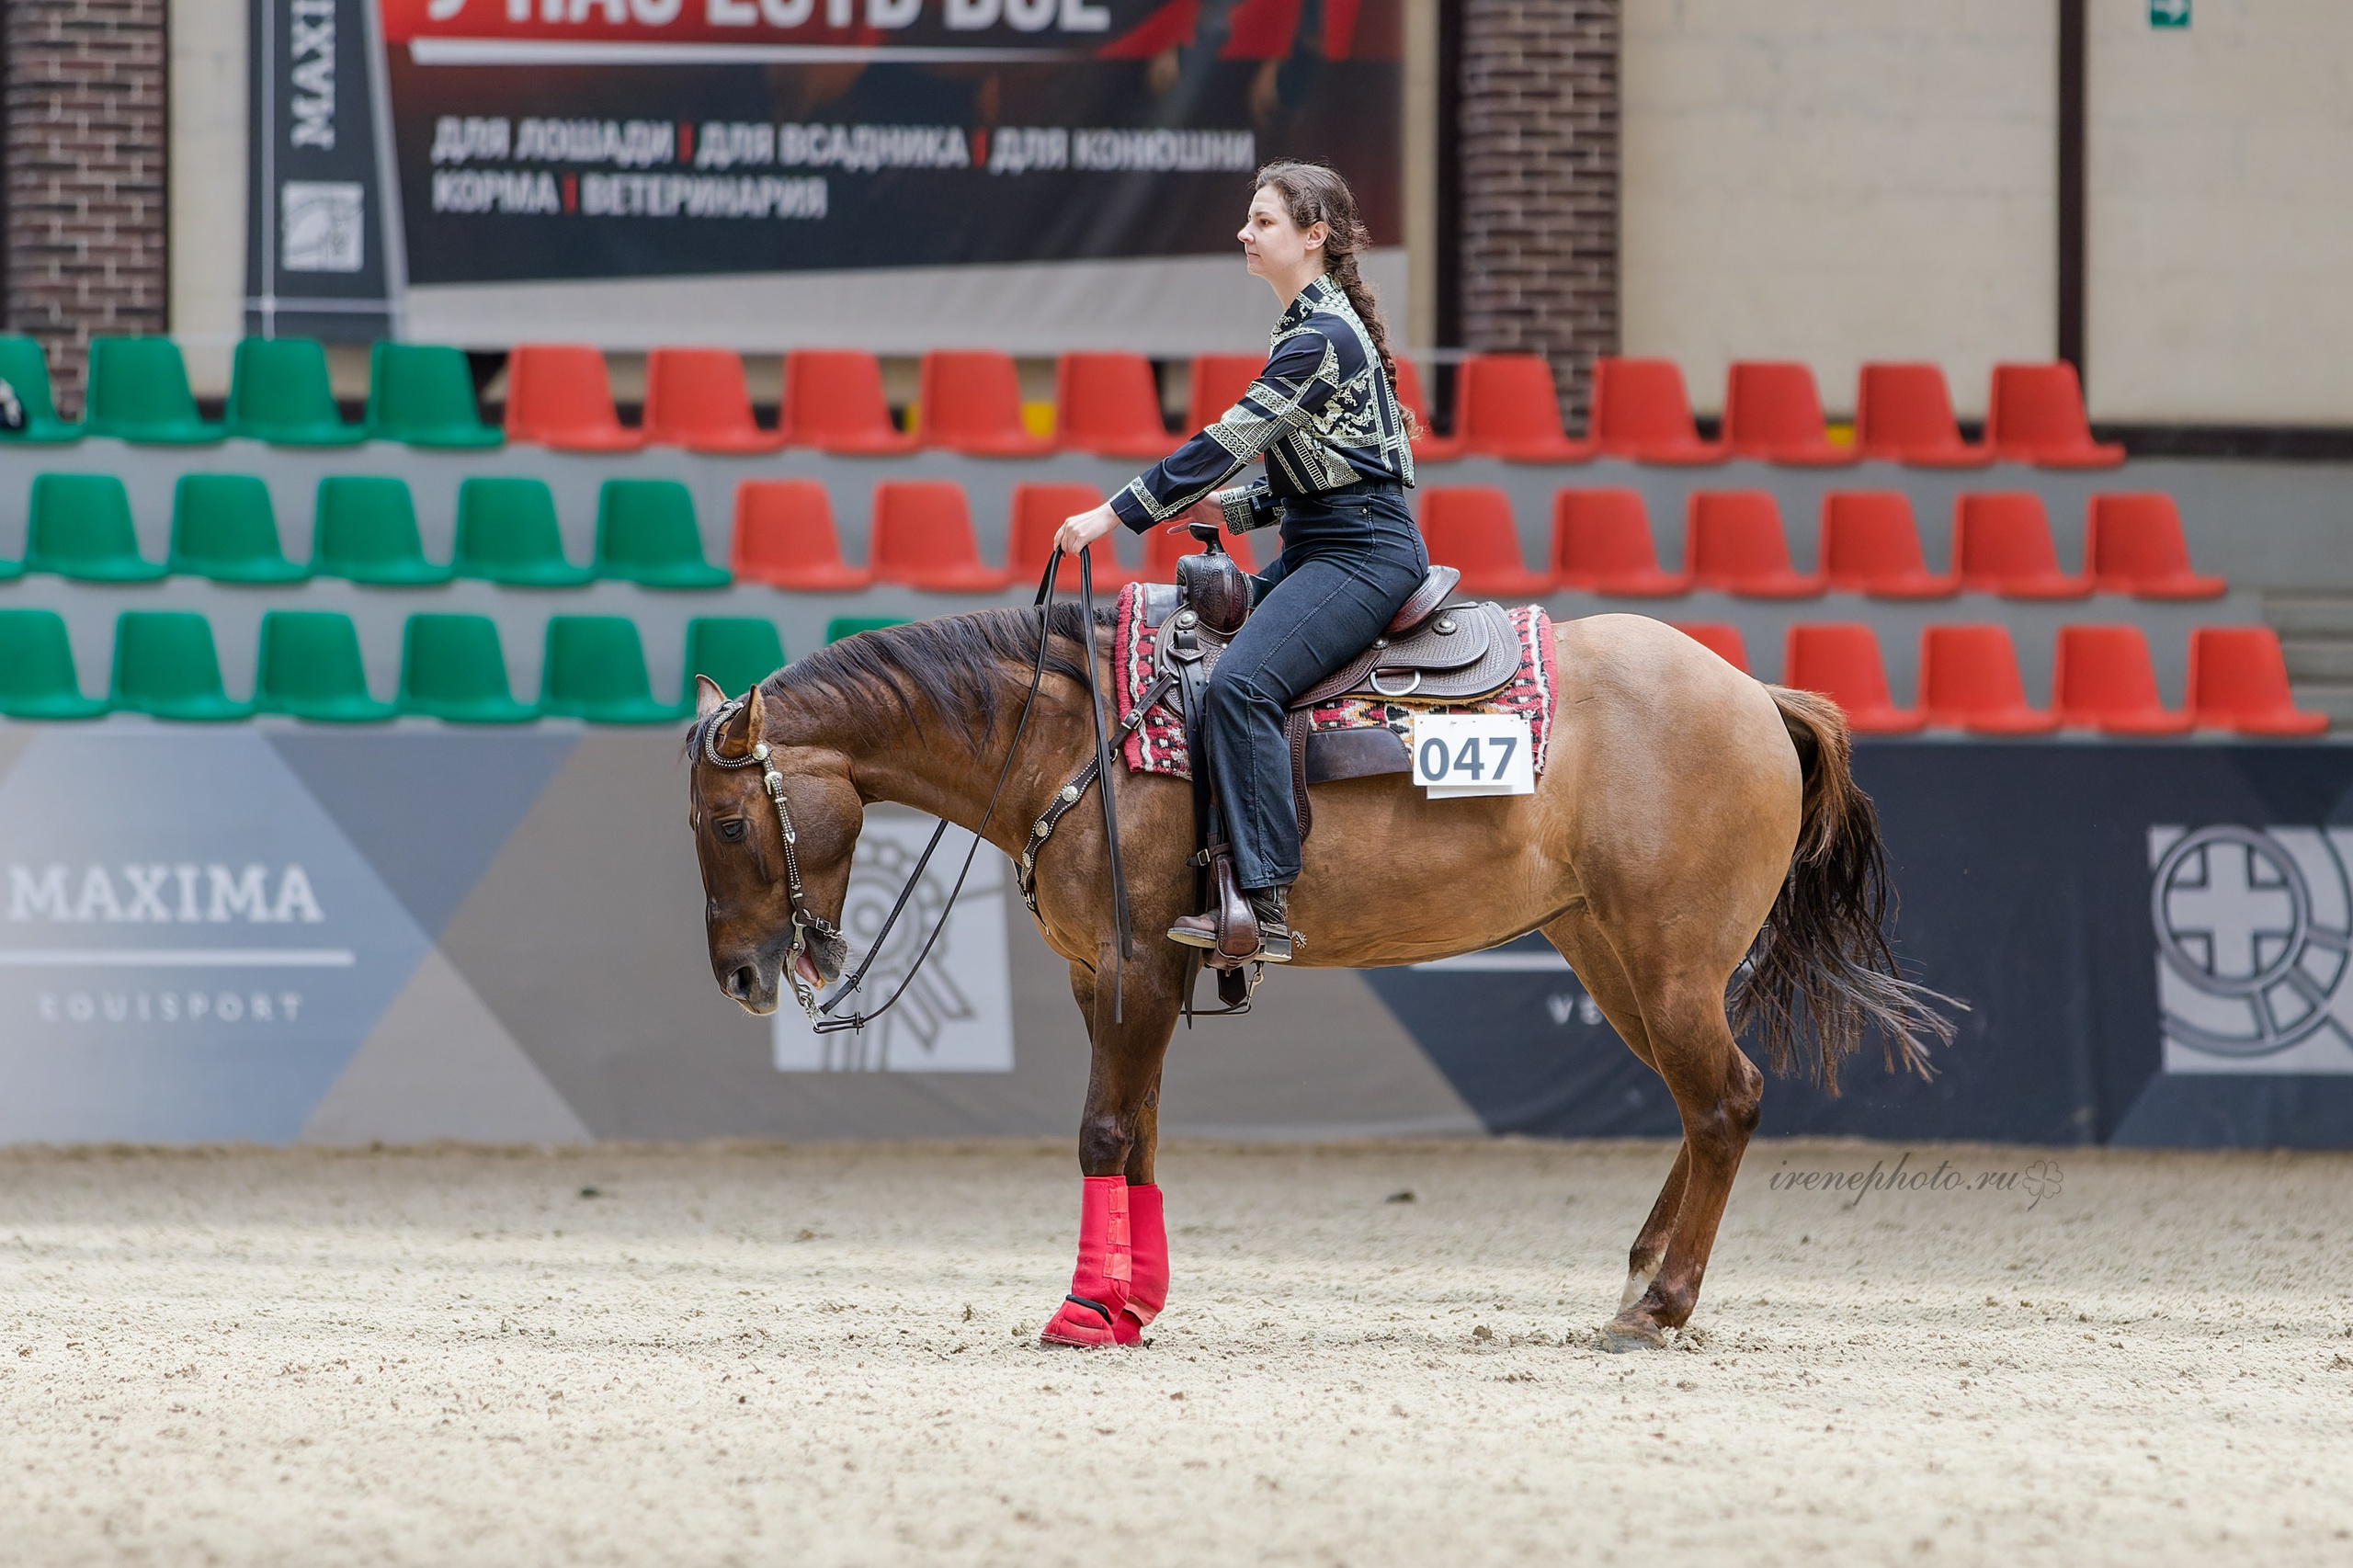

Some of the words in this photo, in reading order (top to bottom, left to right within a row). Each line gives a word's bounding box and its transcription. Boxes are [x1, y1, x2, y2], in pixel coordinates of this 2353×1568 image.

[431, 117, 510, 164] ДЛЯ
[516, 119, 674, 168] ЛОШАДИ
[695, 121, 775, 169] ДЛЯ
[779, 123, 969, 172] ВСАДНИКА
[989, 127, 1068, 176] ДЛЯ
[1072, 128, 1255, 172] КОНЮШНИ
[432, 170, 561, 212] КОРМА
[581, 173, 826, 218] ВЕТЕРИНАРИЯ
[1419, 737, 1518, 781] 047
[9, 863, 324, 922] MAXIMA
